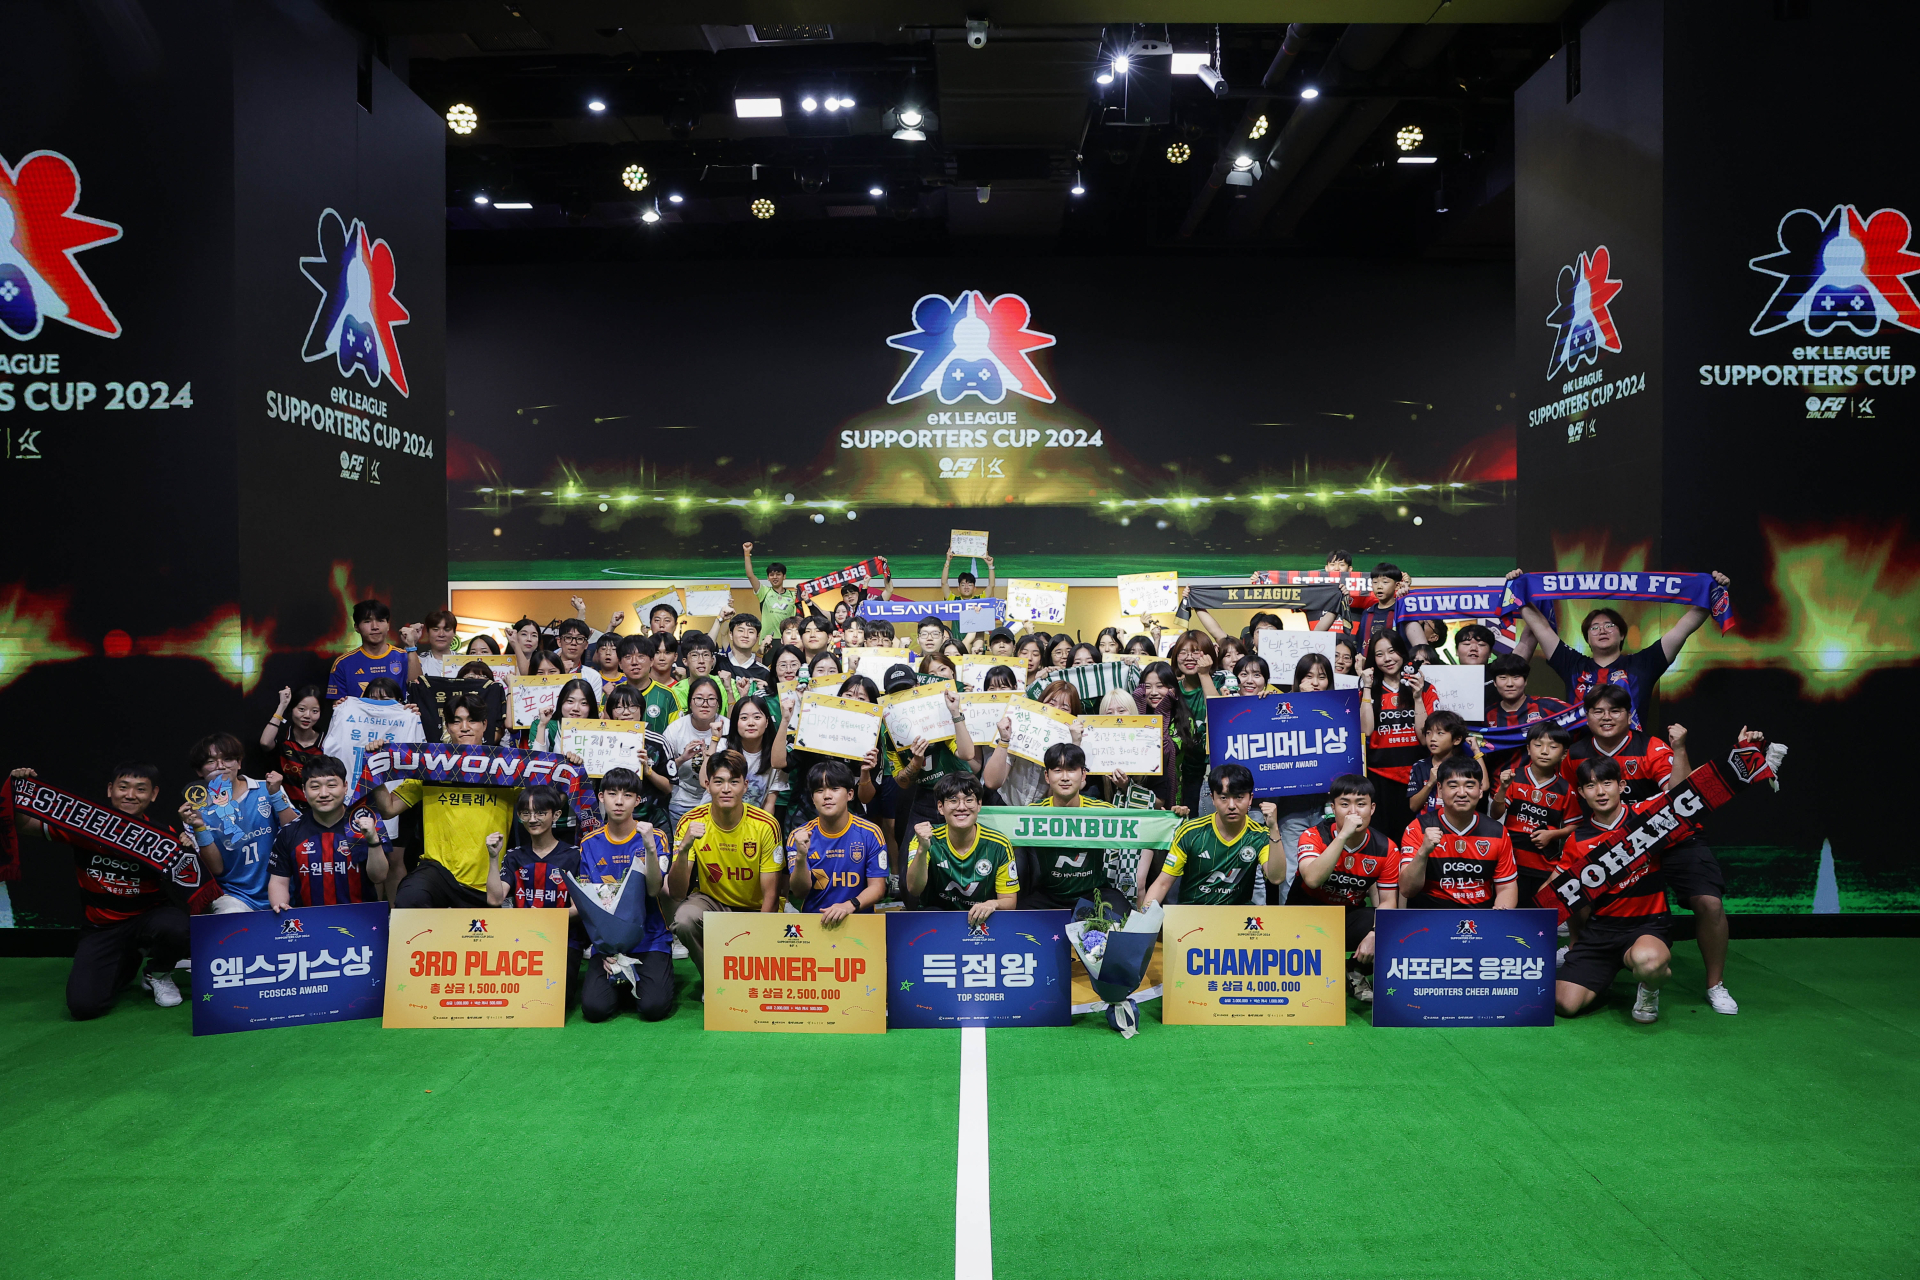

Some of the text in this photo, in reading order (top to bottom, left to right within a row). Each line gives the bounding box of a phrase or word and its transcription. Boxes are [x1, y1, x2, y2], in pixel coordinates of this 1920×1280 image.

[1792, 345, 1891, 361] eK LEAGUE
[1563, 369, 1603, 395] eK LEAGUE
[1699, 364, 1917, 387] SUPPORTERS CUP
[24, 381, 97, 412] CUP
[104, 381, 194, 411] 2024
[330, 386, 388, 419] eK LEAGUE
[1528, 372, 1646, 428] SUPPORTERS CUP 2024
[266, 391, 434, 460] SUPPORTERS CUP 2024
[926, 411, 1017, 426] eK LEAGUE
[840, 429, 1104, 449] SUPPORTERS CUP 2024
[803, 564, 867, 595] STEELERS
[1542, 573, 1682, 595] SUWON FC
[1228, 588, 1301, 601] K LEAGUE
[1404, 593, 1490, 613] SUWON
[866, 604, 932, 616] ULSAN
[936, 603, 962, 614] HD
[358, 715, 405, 728] LASHEVAN
[1379, 709, 1416, 723] posco
[1224, 726, 1349, 762] 세리머니상
[367, 751, 522, 778] SUWON
[524, 761, 578, 786] FC
[1259, 759, 1318, 772] CEREMONY AWARD
[437, 792, 497, 807] 수원특례시
[1520, 802, 1548, 817] posco
[32, 786, 178, 863] STEELERS
[1014, 816, 1140, 839] JEONBUK
[241, 841, 260, 866] 27
[1556, 788, 1704, 907] POHANG
[91, 854, 140, 872] posco
[299, 861, 360, 877] 수원특례시
[1443, 861, 1483, 875] posco
[727, 866, 754, 881] HD
[832, 871, 861, 888] HD
[1063, 869, 1094, 879] HYUNDAI
[1327, 873, 1367, 887] posco
[515, 887, 568, 902] 수원특례시
[209, 945, 374, 990] 엪스카스상
[409, 950, 544, 977] 3RD PLACE
[922, 952, 1037, 989] 득점왕
[1186, 947, 1322, 977] CHAMPION
[1386, 957, 1545, 981] 서포터즈 응원상
[259, 983, 329, 1000] FCOSCAS AWARD
[430, 982, 520, 995] 총 상금 1,500,000
[748, 988, 841, 1001] 총 상금 2,500,000
[1207, 980, 1301, 994] 총 상금 4,000,000
[1413, 987, 1519, 996] SUPPORTERS CHEER AWARD
[956, 992, 1005, 1002] TOP SCORER
